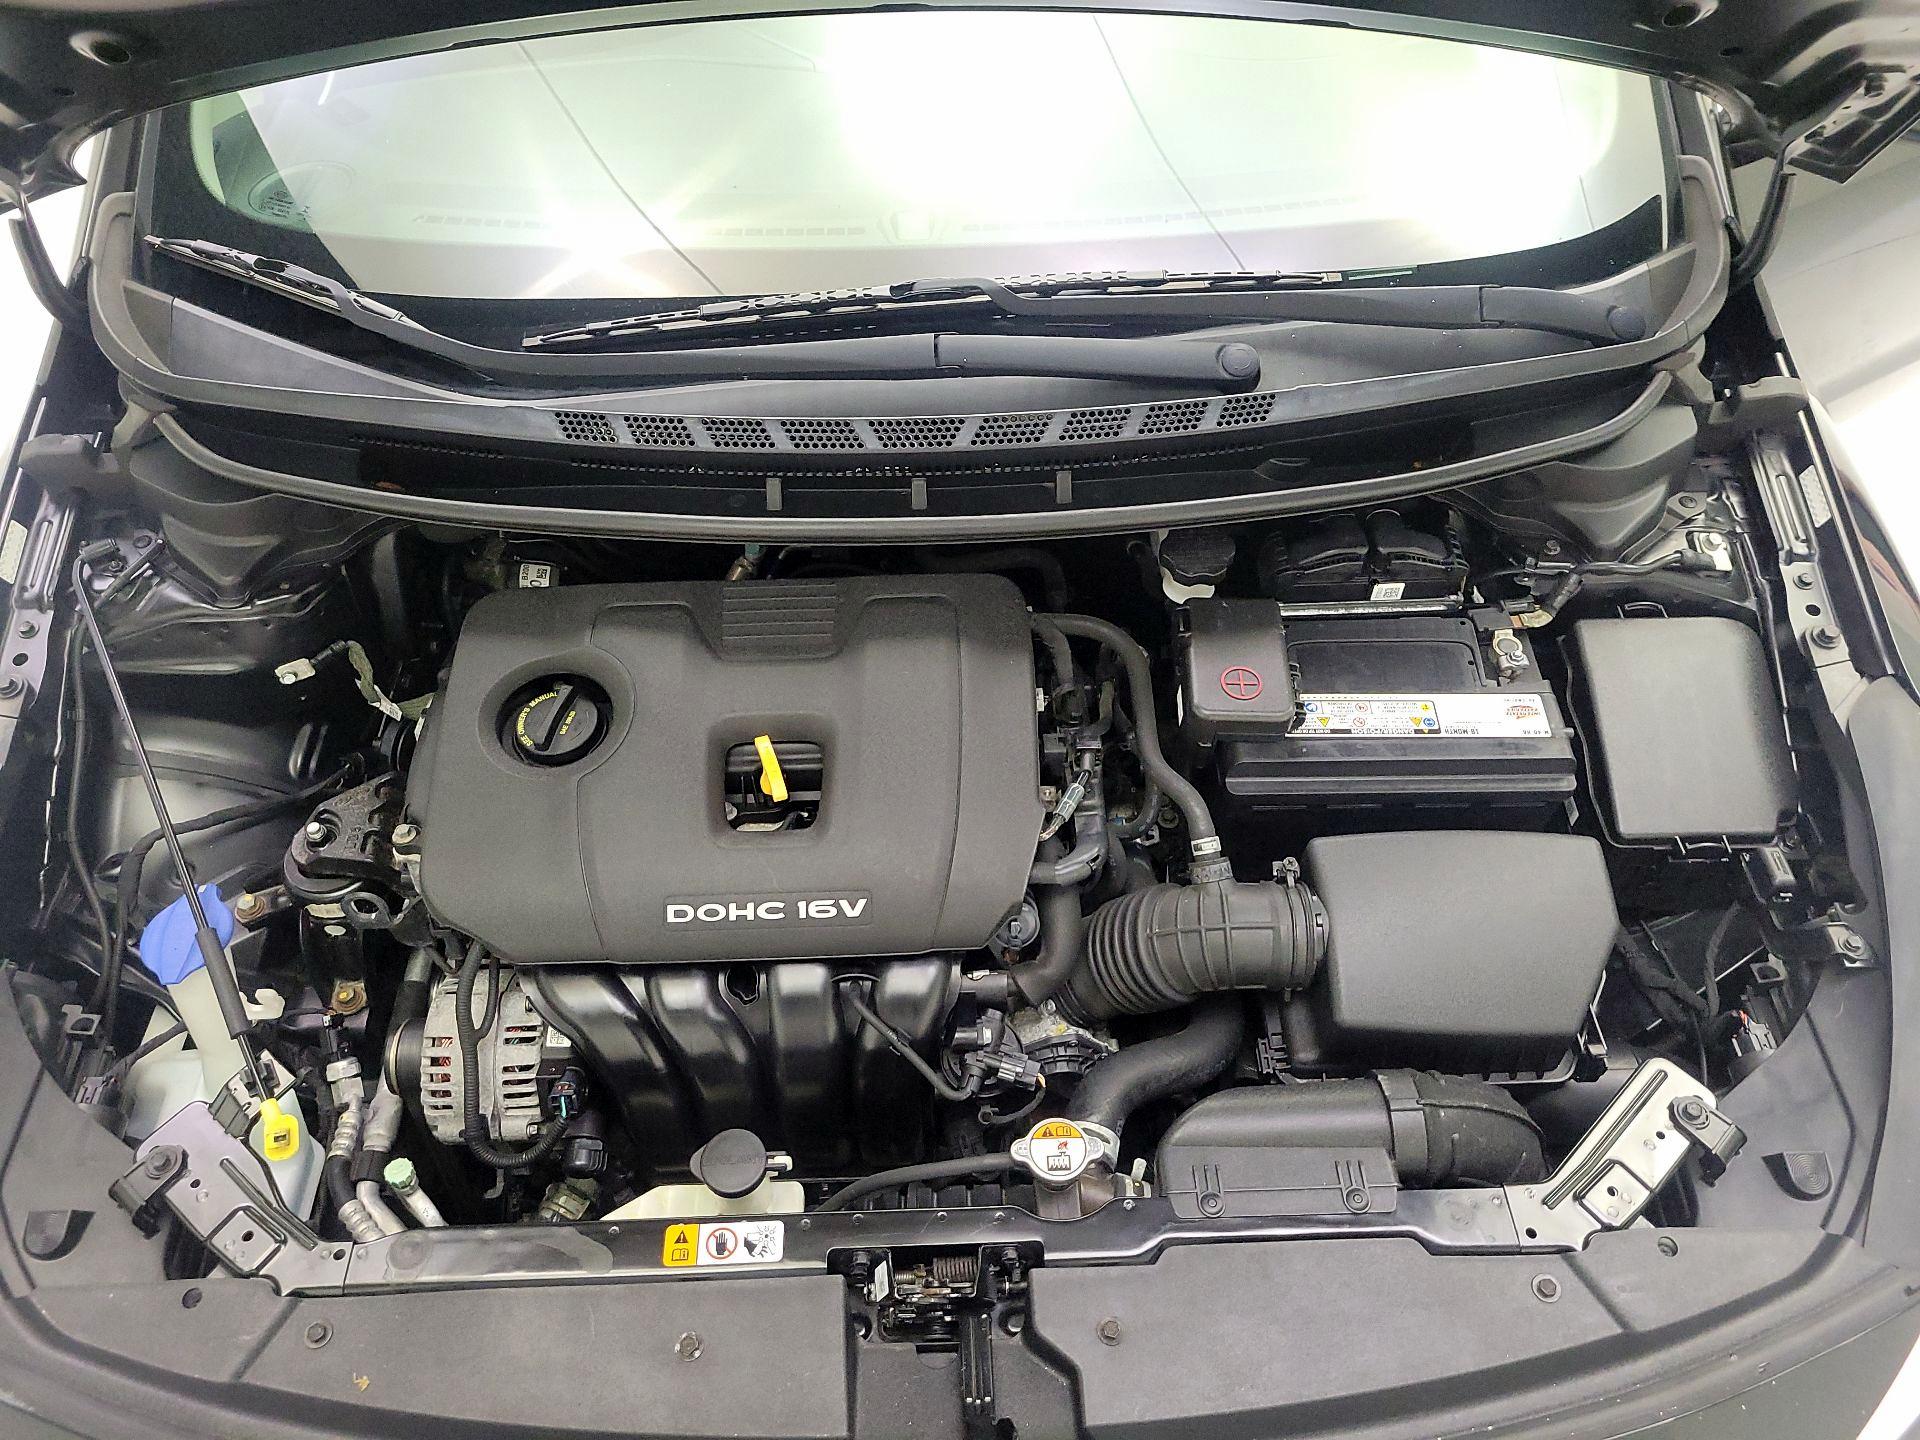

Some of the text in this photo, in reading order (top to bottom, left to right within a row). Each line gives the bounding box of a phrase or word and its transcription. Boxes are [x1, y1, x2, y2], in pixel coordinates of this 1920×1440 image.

[517, 691, 558, 747] SEE OWNER'S MANUAL
[559, 725, 569, 736] SAE
[666, 898, 868, 923] DOHC 16V
